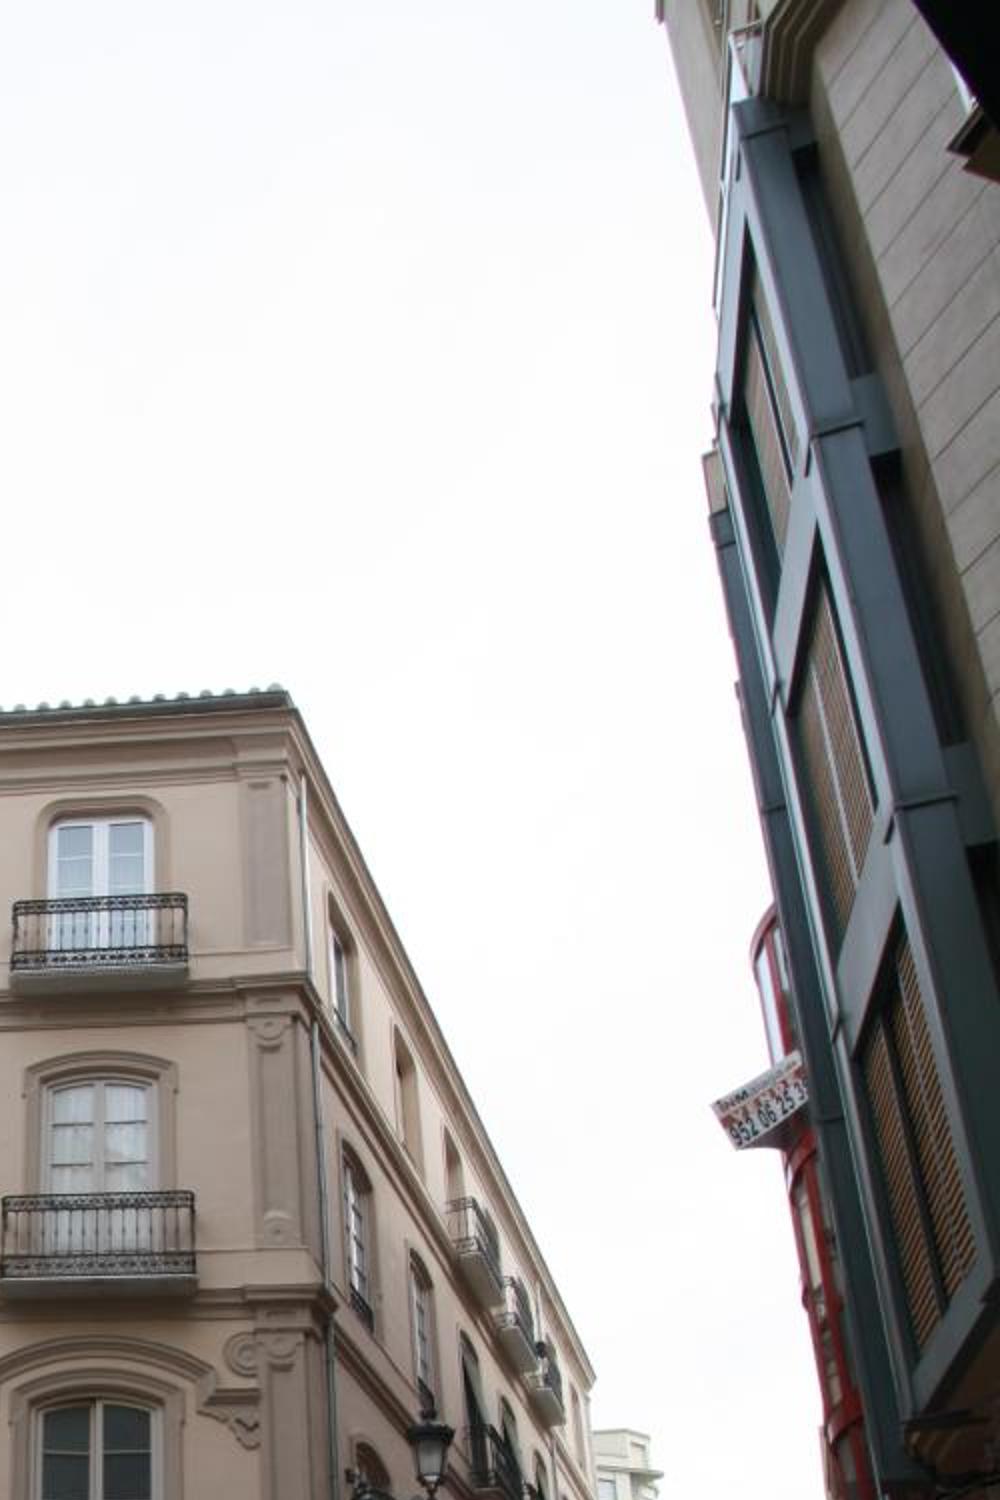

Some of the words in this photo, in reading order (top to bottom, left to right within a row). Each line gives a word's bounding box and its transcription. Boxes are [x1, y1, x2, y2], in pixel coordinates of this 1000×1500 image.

[730, 1117, 759, 1145] 952
[758, 1101, 776, 1127] 06
[776, 1089, 794, 1114] 25
